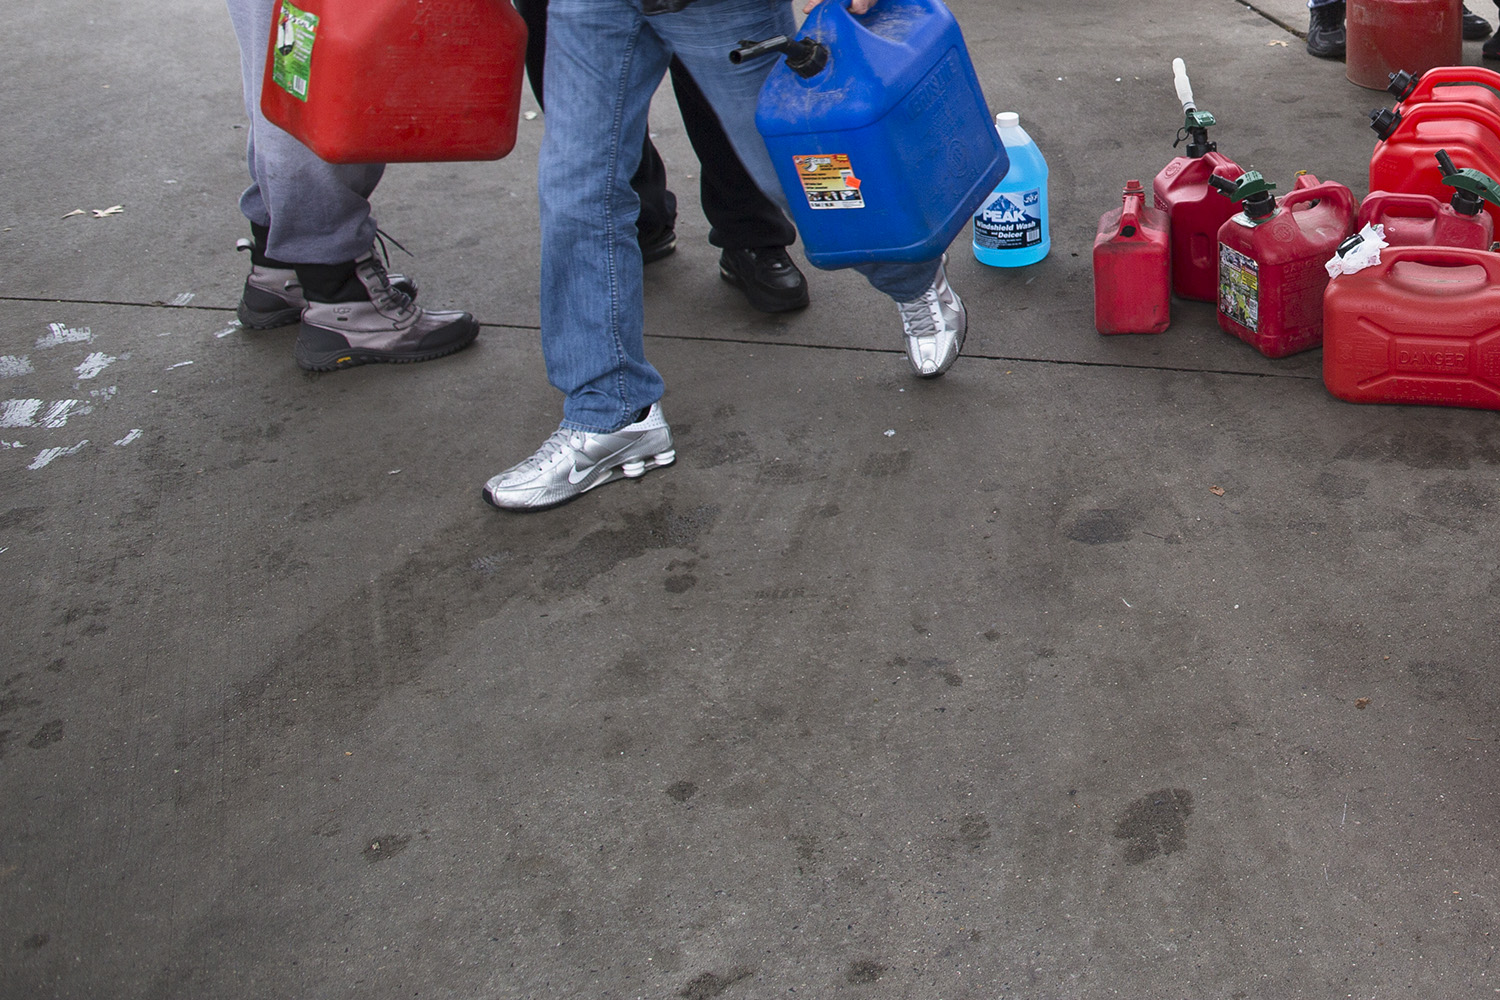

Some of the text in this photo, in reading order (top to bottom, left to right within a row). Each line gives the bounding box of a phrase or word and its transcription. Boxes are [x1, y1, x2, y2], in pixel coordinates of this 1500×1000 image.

[983, 208, 1027, 222] PEAK
[976, 220, 1036, 231] Windshield Wash
[1400, 350, 1466, 366] DANGER
